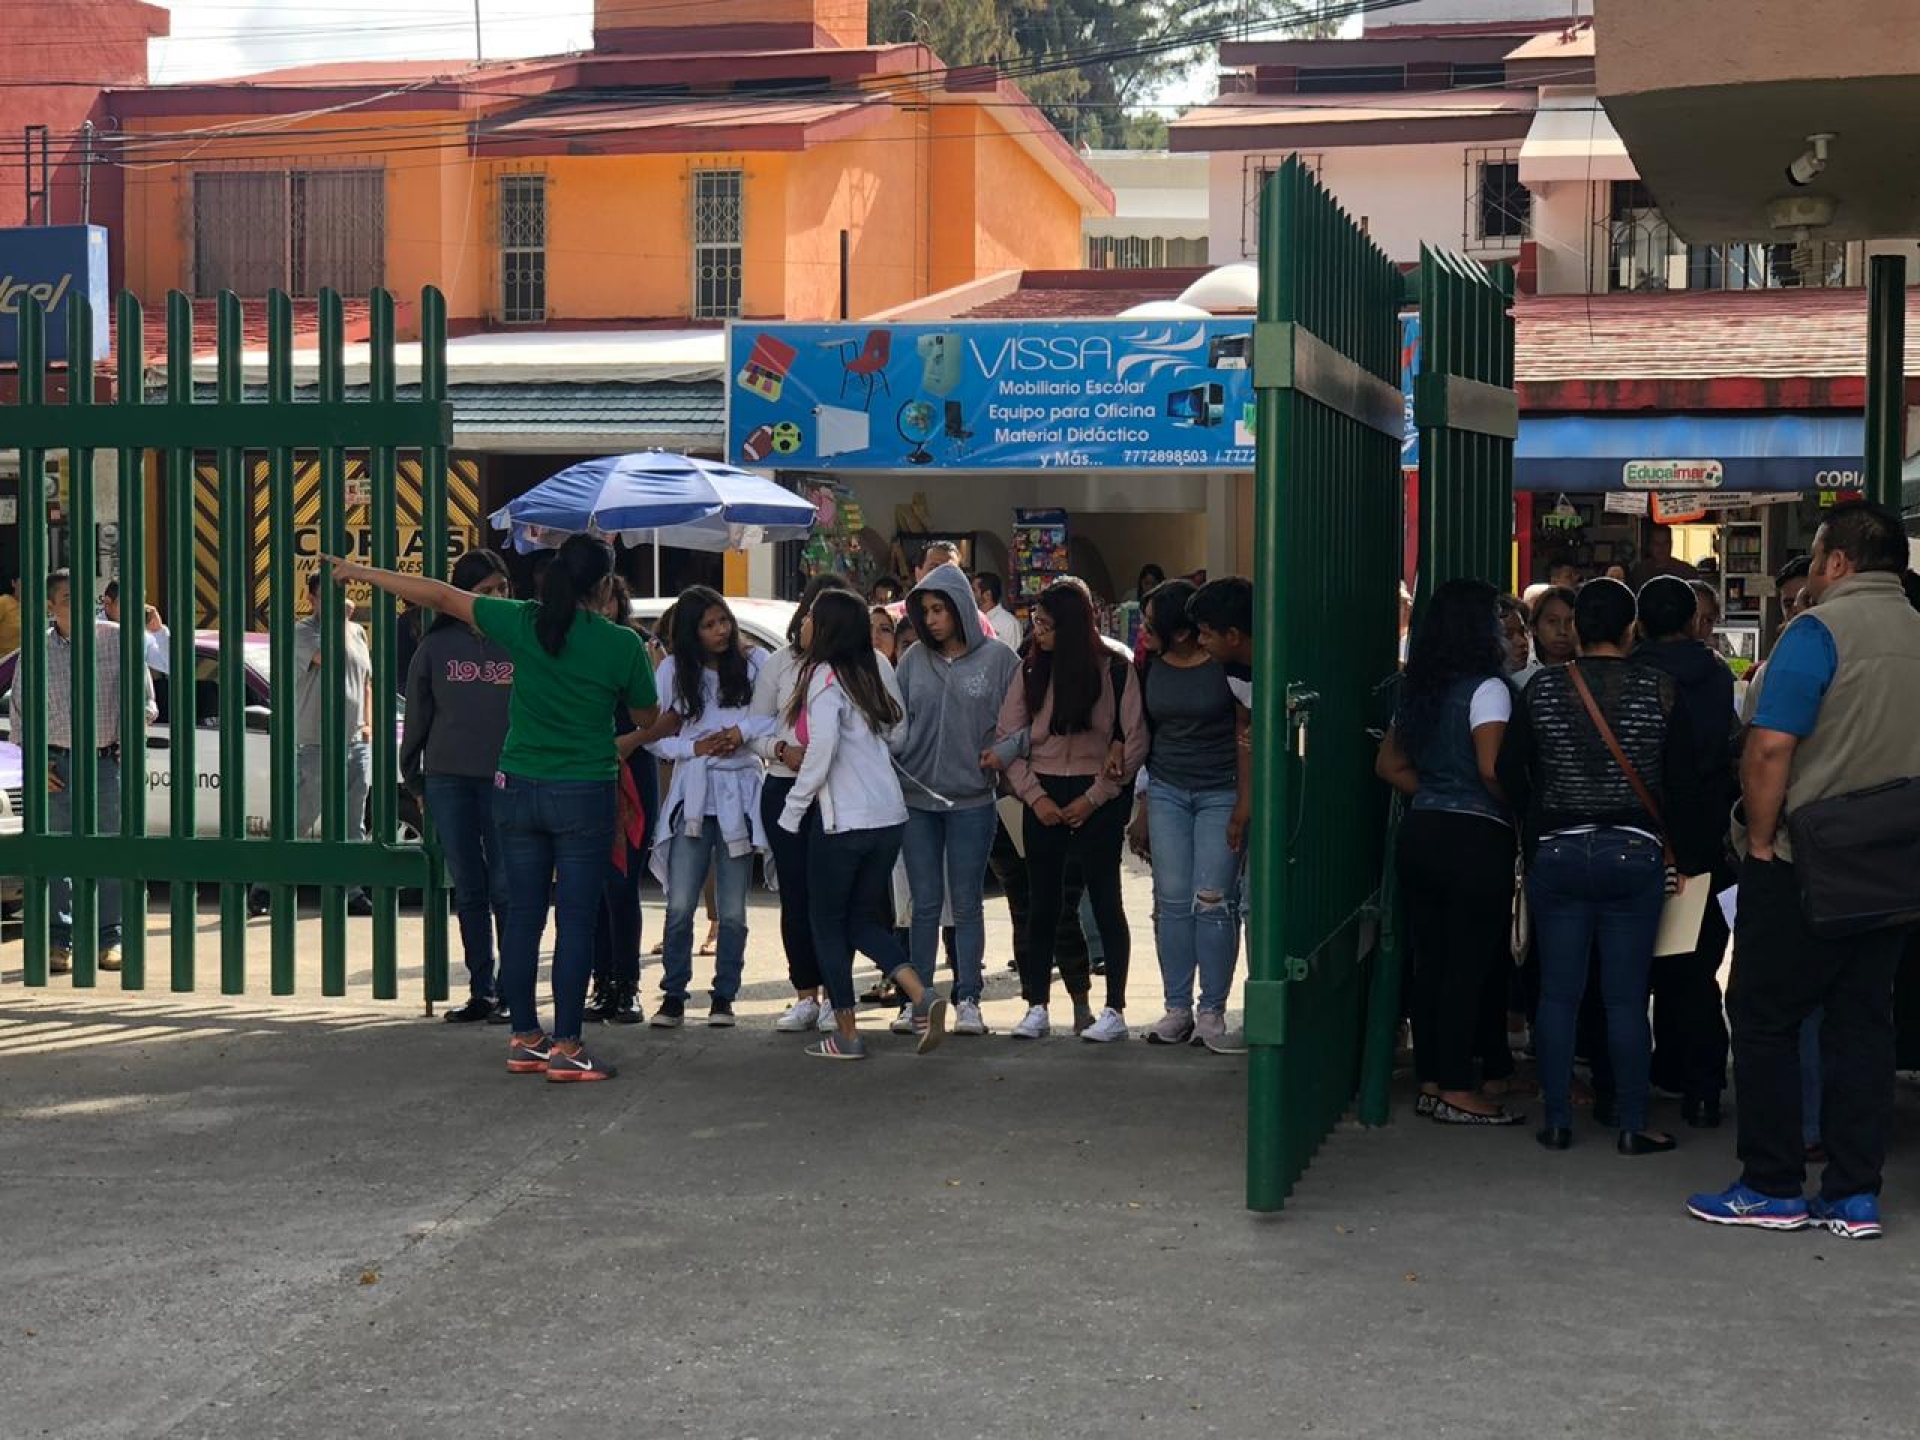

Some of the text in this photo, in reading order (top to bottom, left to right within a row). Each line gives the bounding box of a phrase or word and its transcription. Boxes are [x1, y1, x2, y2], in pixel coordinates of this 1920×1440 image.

[969, 337, 1112, 379] VISSA
[999, 380, 1147, 396] Mobiliario Escolar
[989, 403, 1156, 422] Equipo para Oficina
[994, 425, 1150, 443] Material Didáctico
[1040, 454, 1050, 469] y
[1123, 449, 1208, 463] 7772898503
[1627, 462, 1707, 480] Educaimar
